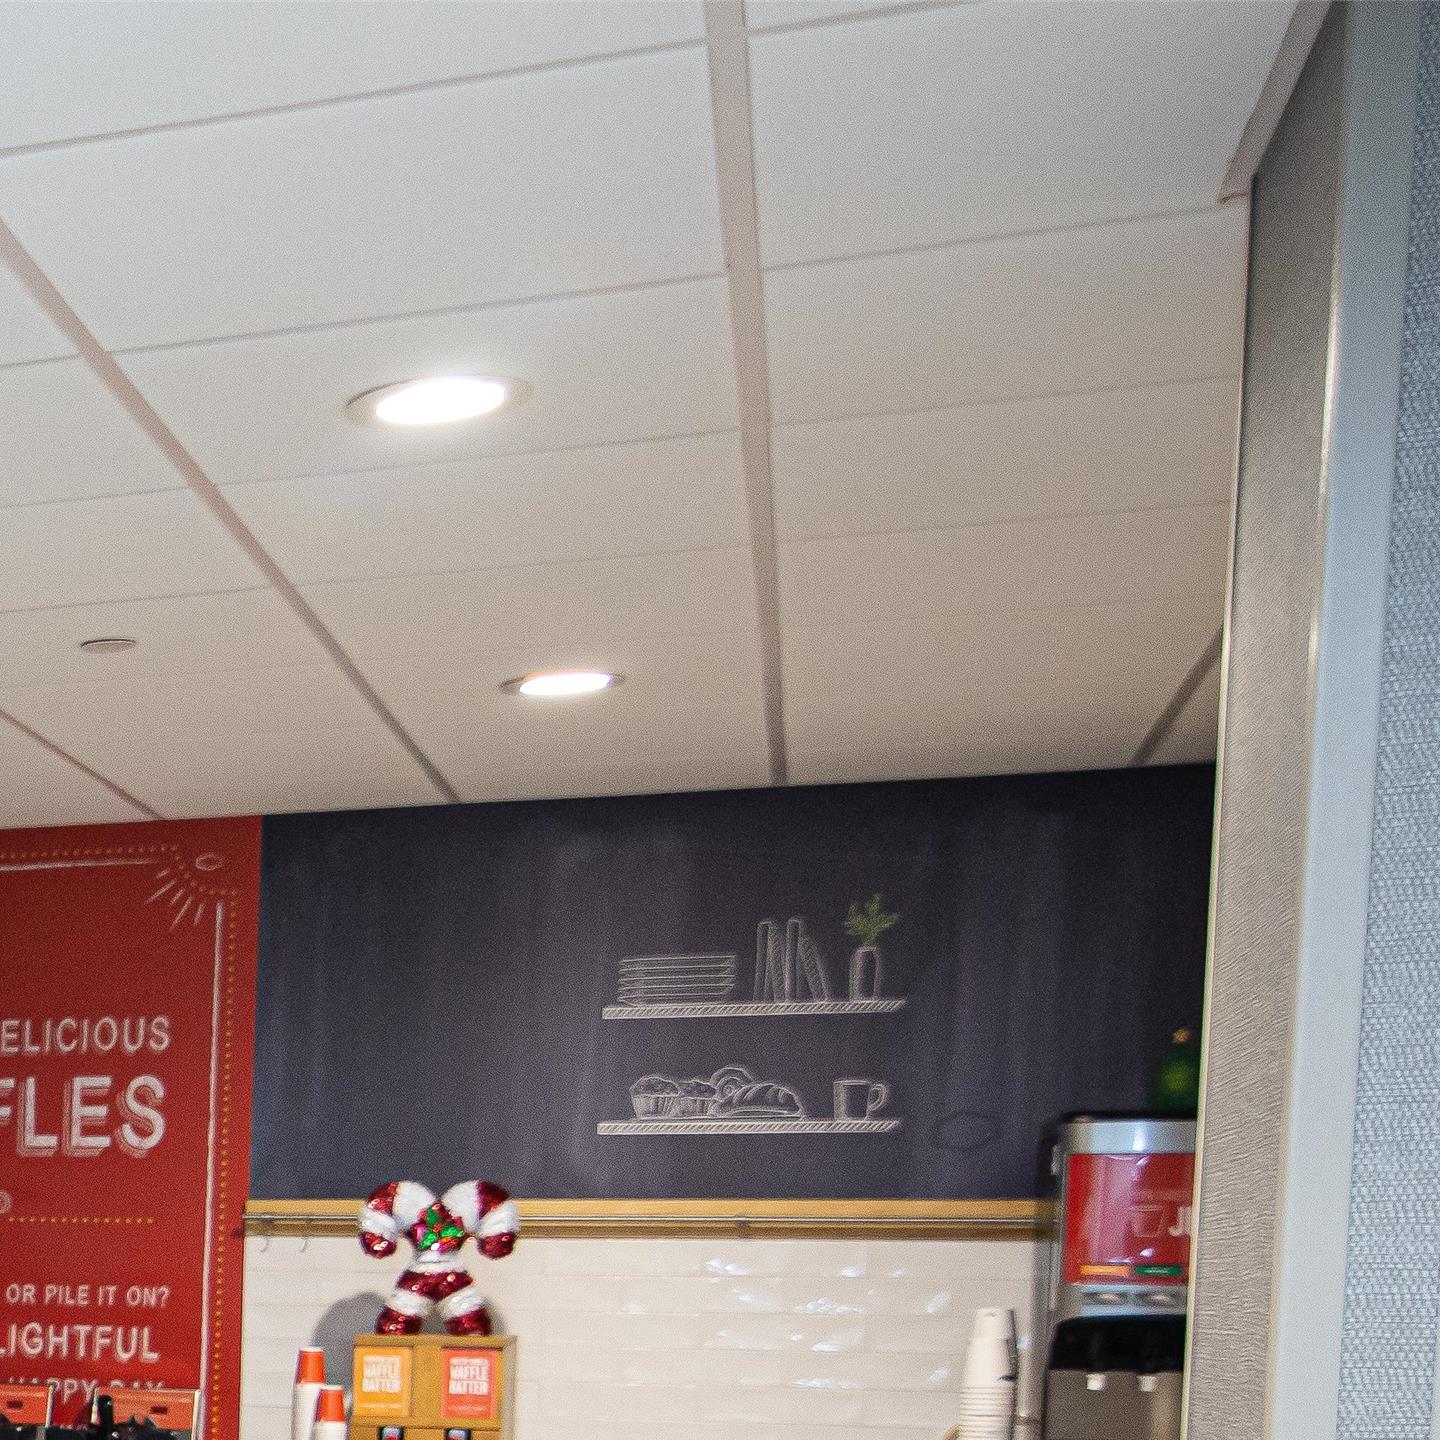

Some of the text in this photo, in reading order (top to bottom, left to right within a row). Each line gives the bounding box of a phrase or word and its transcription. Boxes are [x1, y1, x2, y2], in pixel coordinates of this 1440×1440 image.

[5, 1283, 37, 1305] OR
[45, 1284, 89, 1306] PILE
[98, 1285, 117, 1306] IT
[126, 1285, 170, 1308] ON?
[364, 1364, 401, 1379] WAFFLE
[450, 1366, 489, 1381] WAFFLE
[362, 1379, 401, 1393] BATTER
[449, 1380, 489, 1395] BATTER
